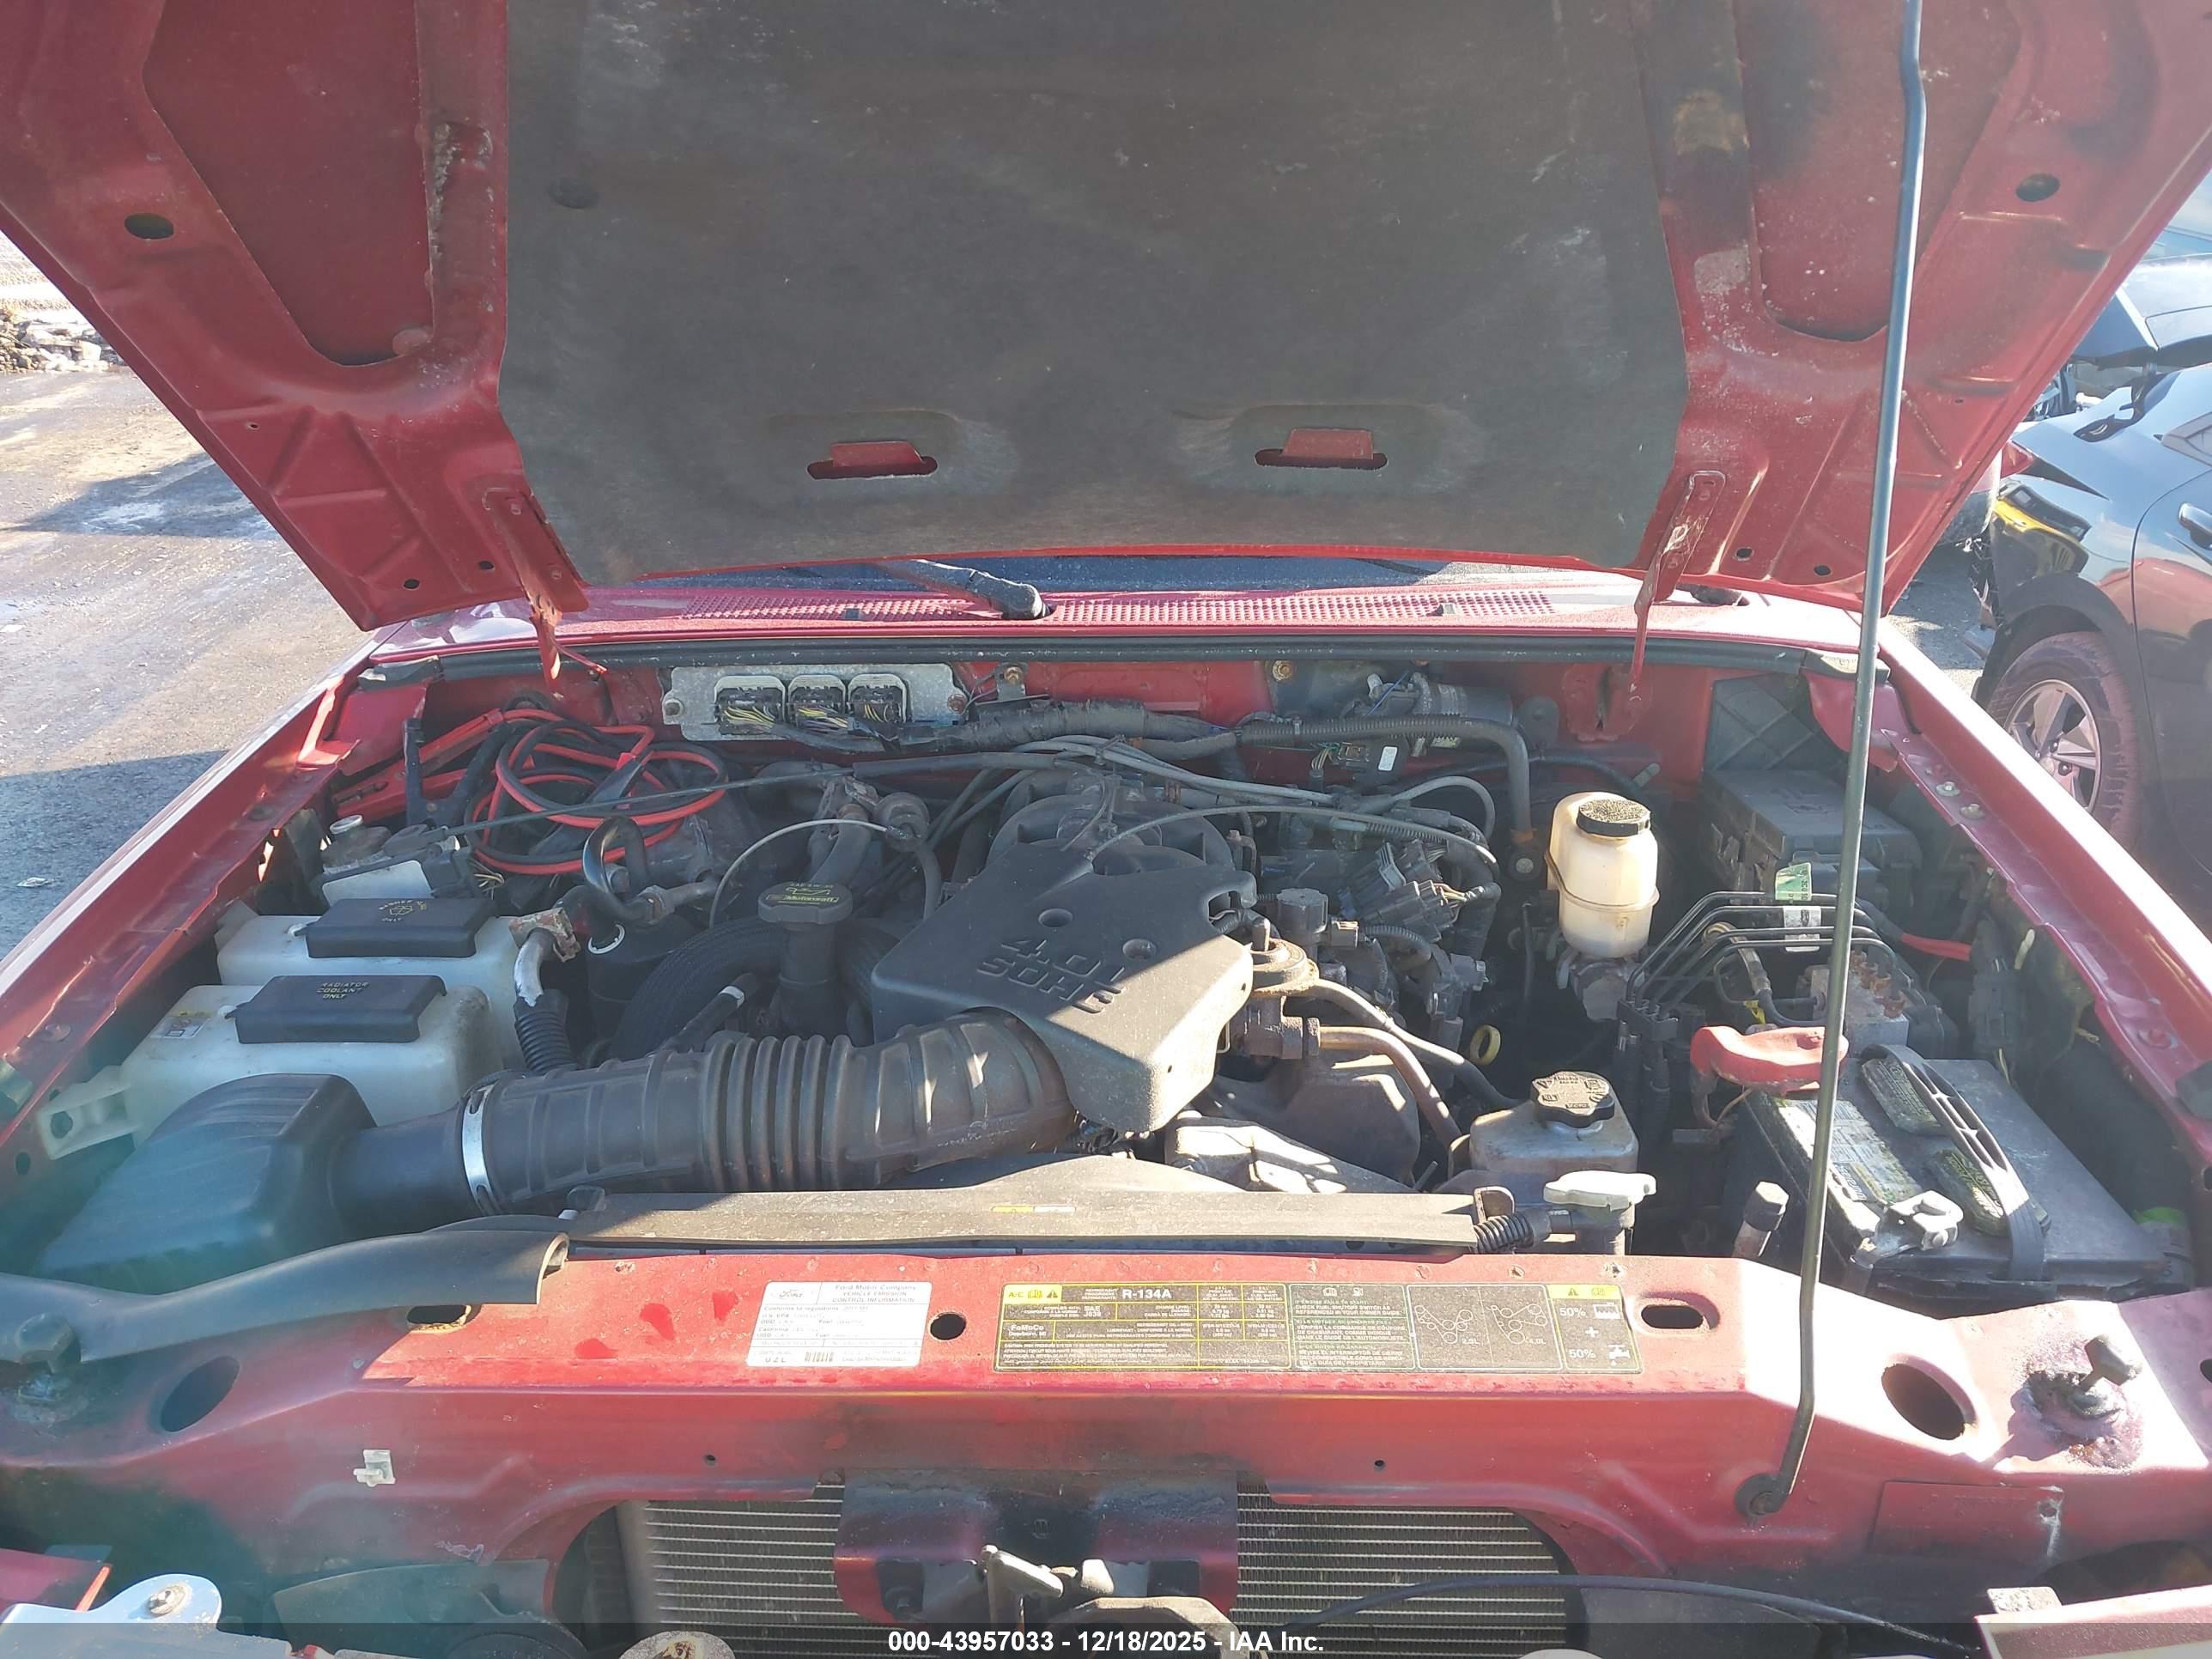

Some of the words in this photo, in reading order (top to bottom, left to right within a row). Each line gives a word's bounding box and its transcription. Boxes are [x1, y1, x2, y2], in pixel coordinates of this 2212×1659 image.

[976, 957, 1115, 1014] SOHC
[1121, 1288, 1172, 1299] R-134A
[1559, 1307, 1587, 1317] 50%
[1569, 1349, 1597, 1359] 50%
